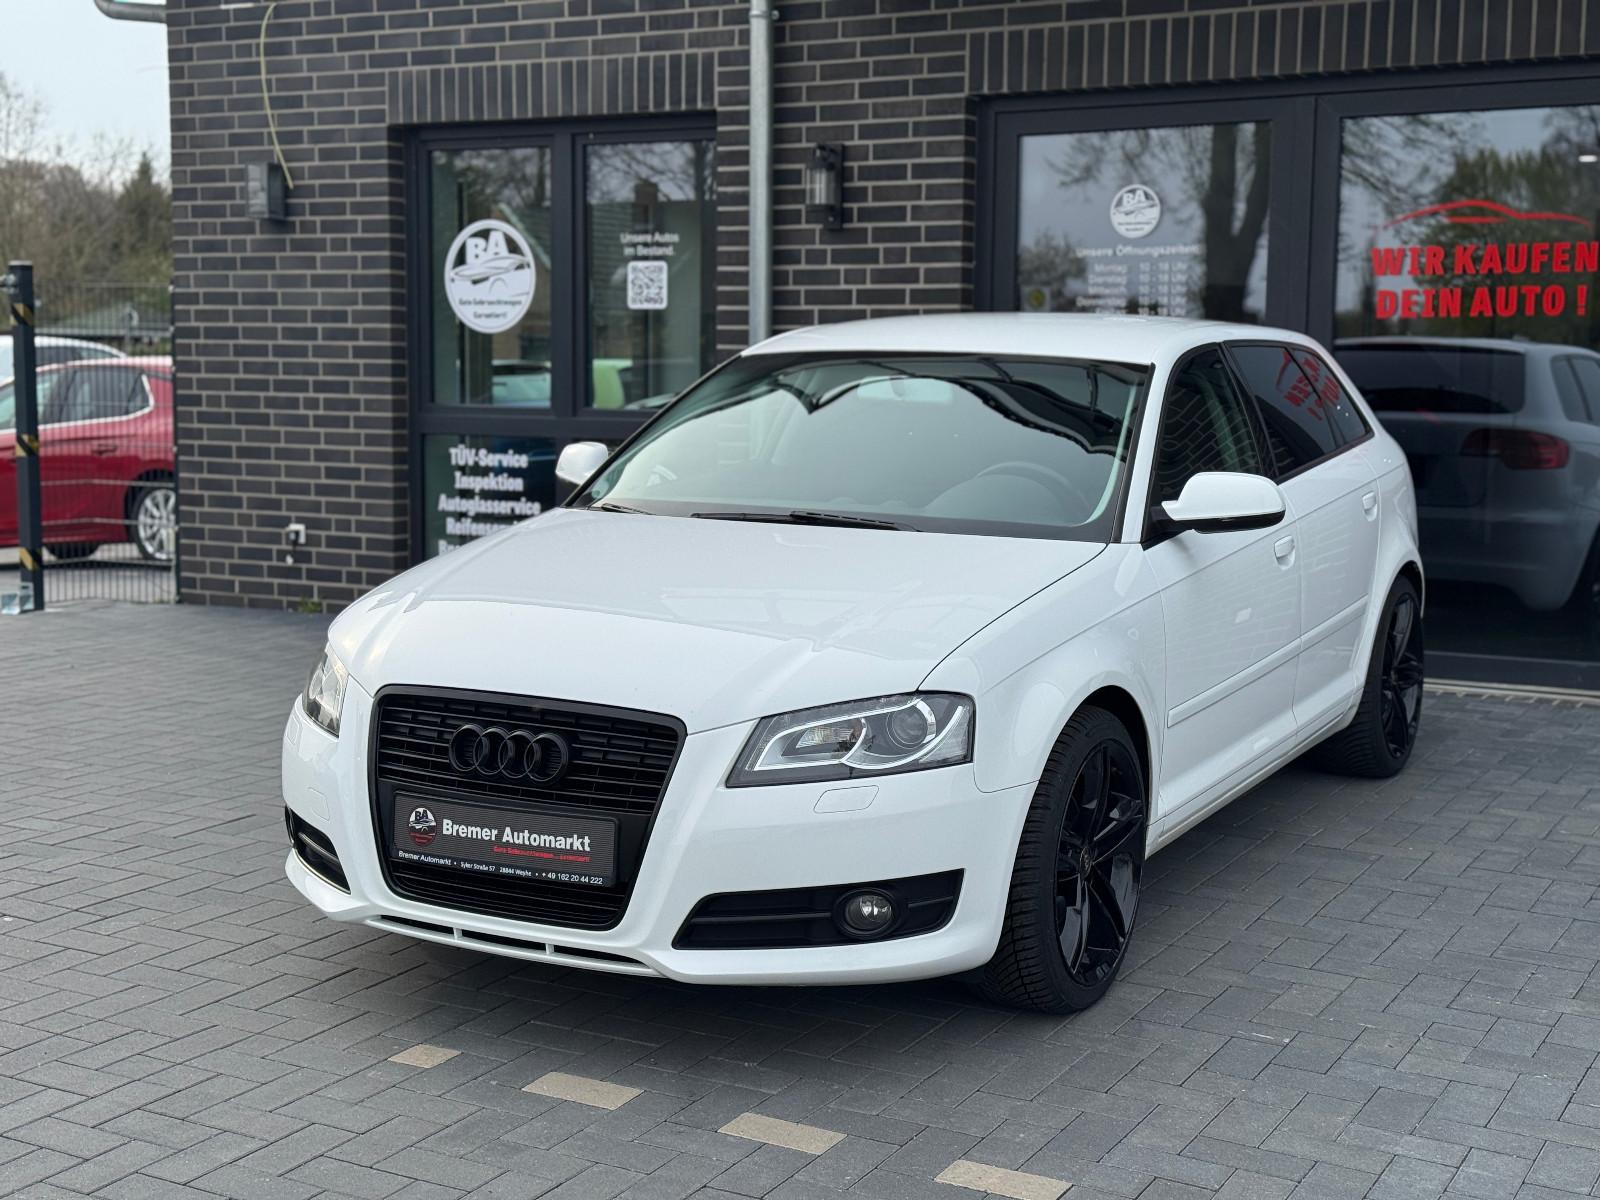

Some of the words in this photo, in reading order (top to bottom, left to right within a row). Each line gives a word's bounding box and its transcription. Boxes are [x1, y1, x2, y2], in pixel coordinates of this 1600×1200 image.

[1122, 190, 1146, 208] BA
[466, 231, 509, 265] BA
[1371, 245, 1445, 276] WIR
[1453, 240, 1599, 274] KAUFEN
[1375, 287, 1462, 320] DEIN
[1469, 284, 1565, 317] AUTO
[1576, 284, 1588, 316] !
[449, 444, 528, 468] TÜV-Service
[454, 471, 523, 494] Inspektion
[438, 494, 541, 517] Autoglasservice
[415, 810, 429, 821] BA
[442, 818, 498, 841] Bremer
[502, 826, 591, 851] Automarkt
[398, 850, 420, 860] Bremer
[420, 854, 452, 866] Automarkt
[558, 873, 570, 881] 162
[570, 874, 580, 882] 20
[580, 875, 589, 883] 44
